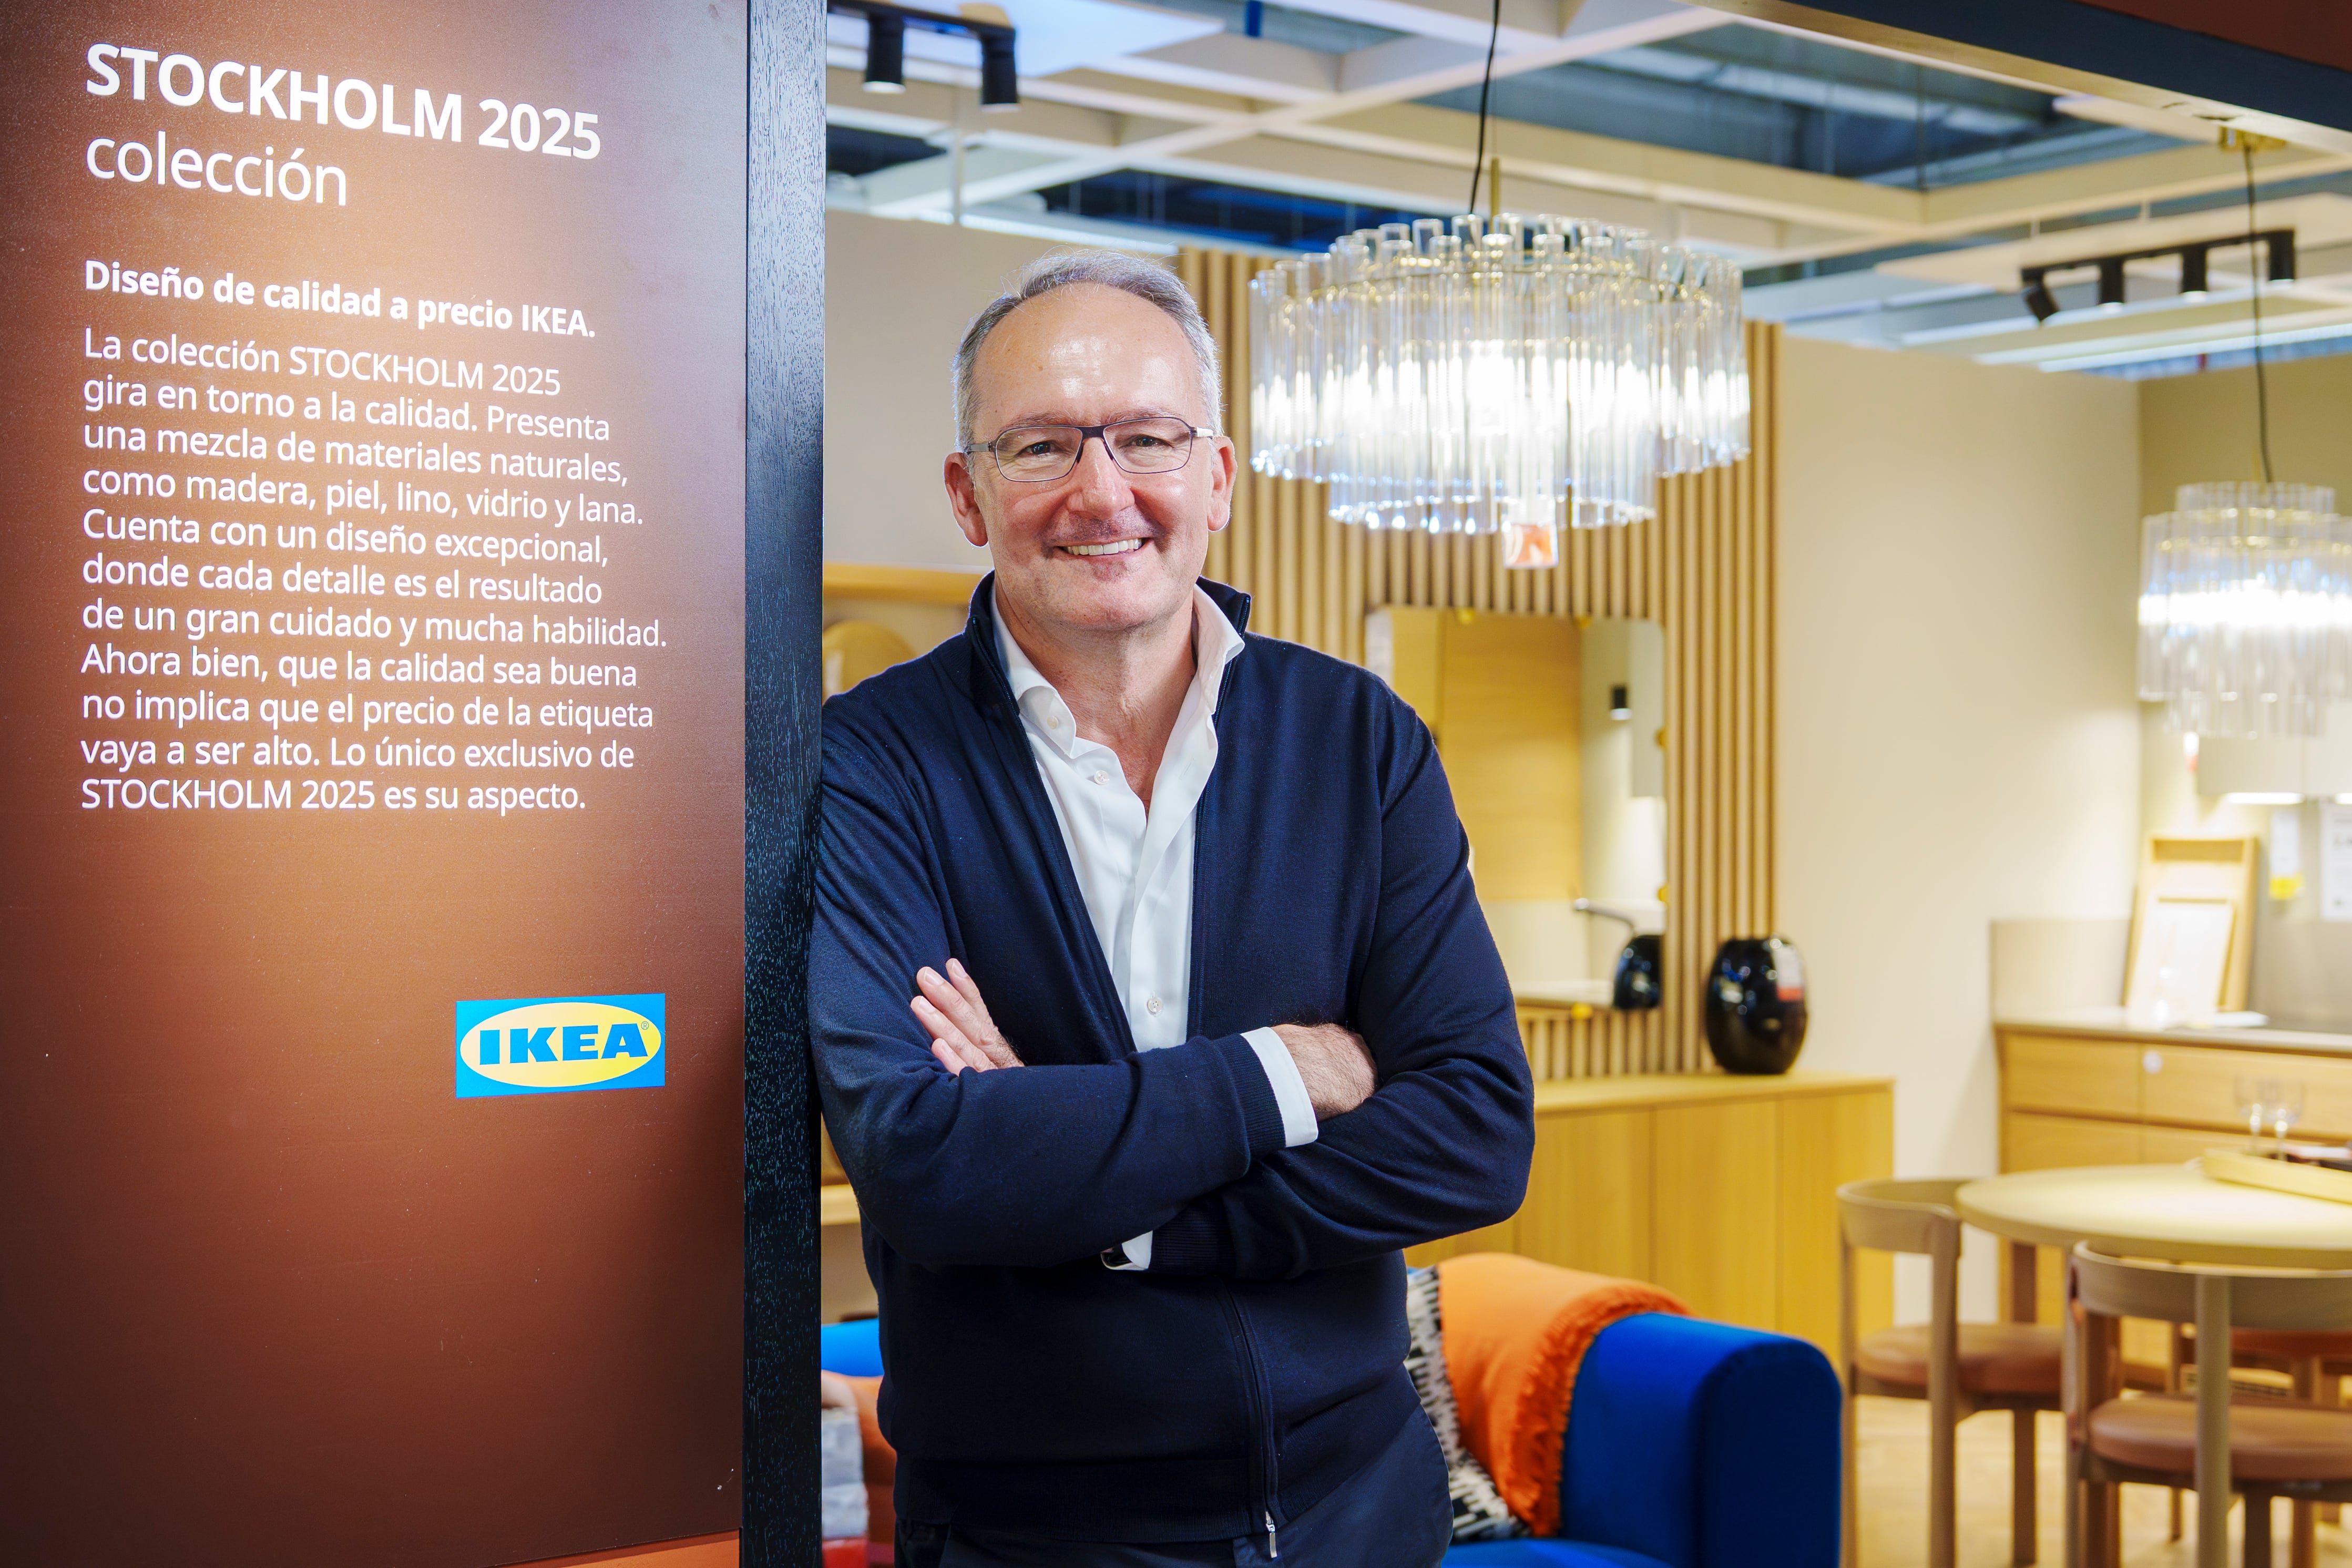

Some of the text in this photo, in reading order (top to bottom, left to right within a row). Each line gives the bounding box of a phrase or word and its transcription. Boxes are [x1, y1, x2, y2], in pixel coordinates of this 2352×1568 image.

[86, 43, 601, 160] STOCKHOLM 2025
[86, 130, 347, 207] colección
[85, 260, 596, 338] Diseño de calidad a precio IKEA.
[85, 327, 561, 396] La colección STOCKHOLM 2025
[83, 373, 610, 441] gira en torno a la calidad. Presenta
[84, 424, 628, 487] una mezcla de materiales naturales,
[83, 469, 643, 528] como madera, piel, lino, vidrio y lana.
[83, 508, 608, 568] Cuenta con un diseño excepcional,
[82, 551, 602, 604] donde cada detalle es el resultado
[82, 597, 667, 648] de un gran cuidado y mucha habilidad.
[80, 642, 637, 688] Ahora bien, que la calidad sea buena
[83, 689, 653, 735] no implica que el precio de la etiqueta
[80, 734, 635, 773] vaya a ser alto. Lo único exclusivo de
[81, 778, 586, 817] STOCKHOLM 2025 es su aspecto.
